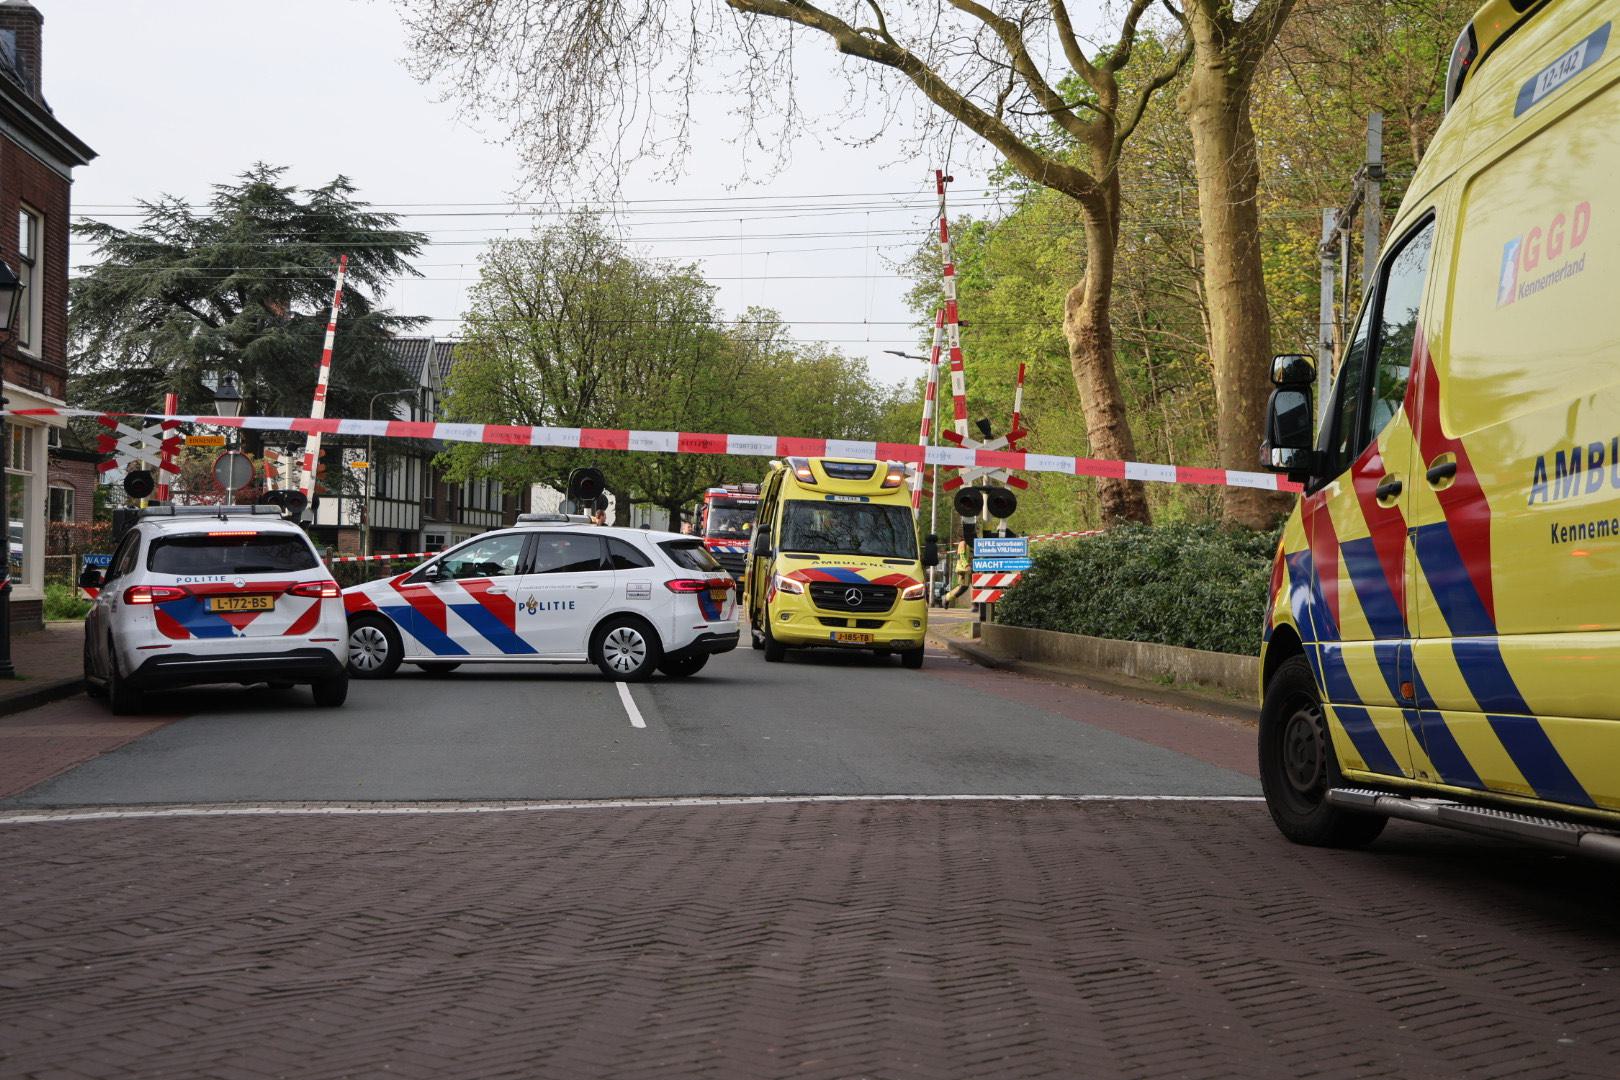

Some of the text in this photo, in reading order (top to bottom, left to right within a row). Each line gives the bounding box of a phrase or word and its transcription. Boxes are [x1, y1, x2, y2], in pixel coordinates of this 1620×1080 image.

[1541, 50, 1580, 92] 12-142
[1523, 201, 1591, 272] GGD
[1518, 251, 1586, 300] Kennemerland
[811, 560, 895, 569] AMBULANCE
[974, 561, 1004, 569] WACHT
[176, 575, 227, 584] POLITIE
[217, 597, 268, 610] L-172-BS
[518, 599, 576, 615] POLITIE
